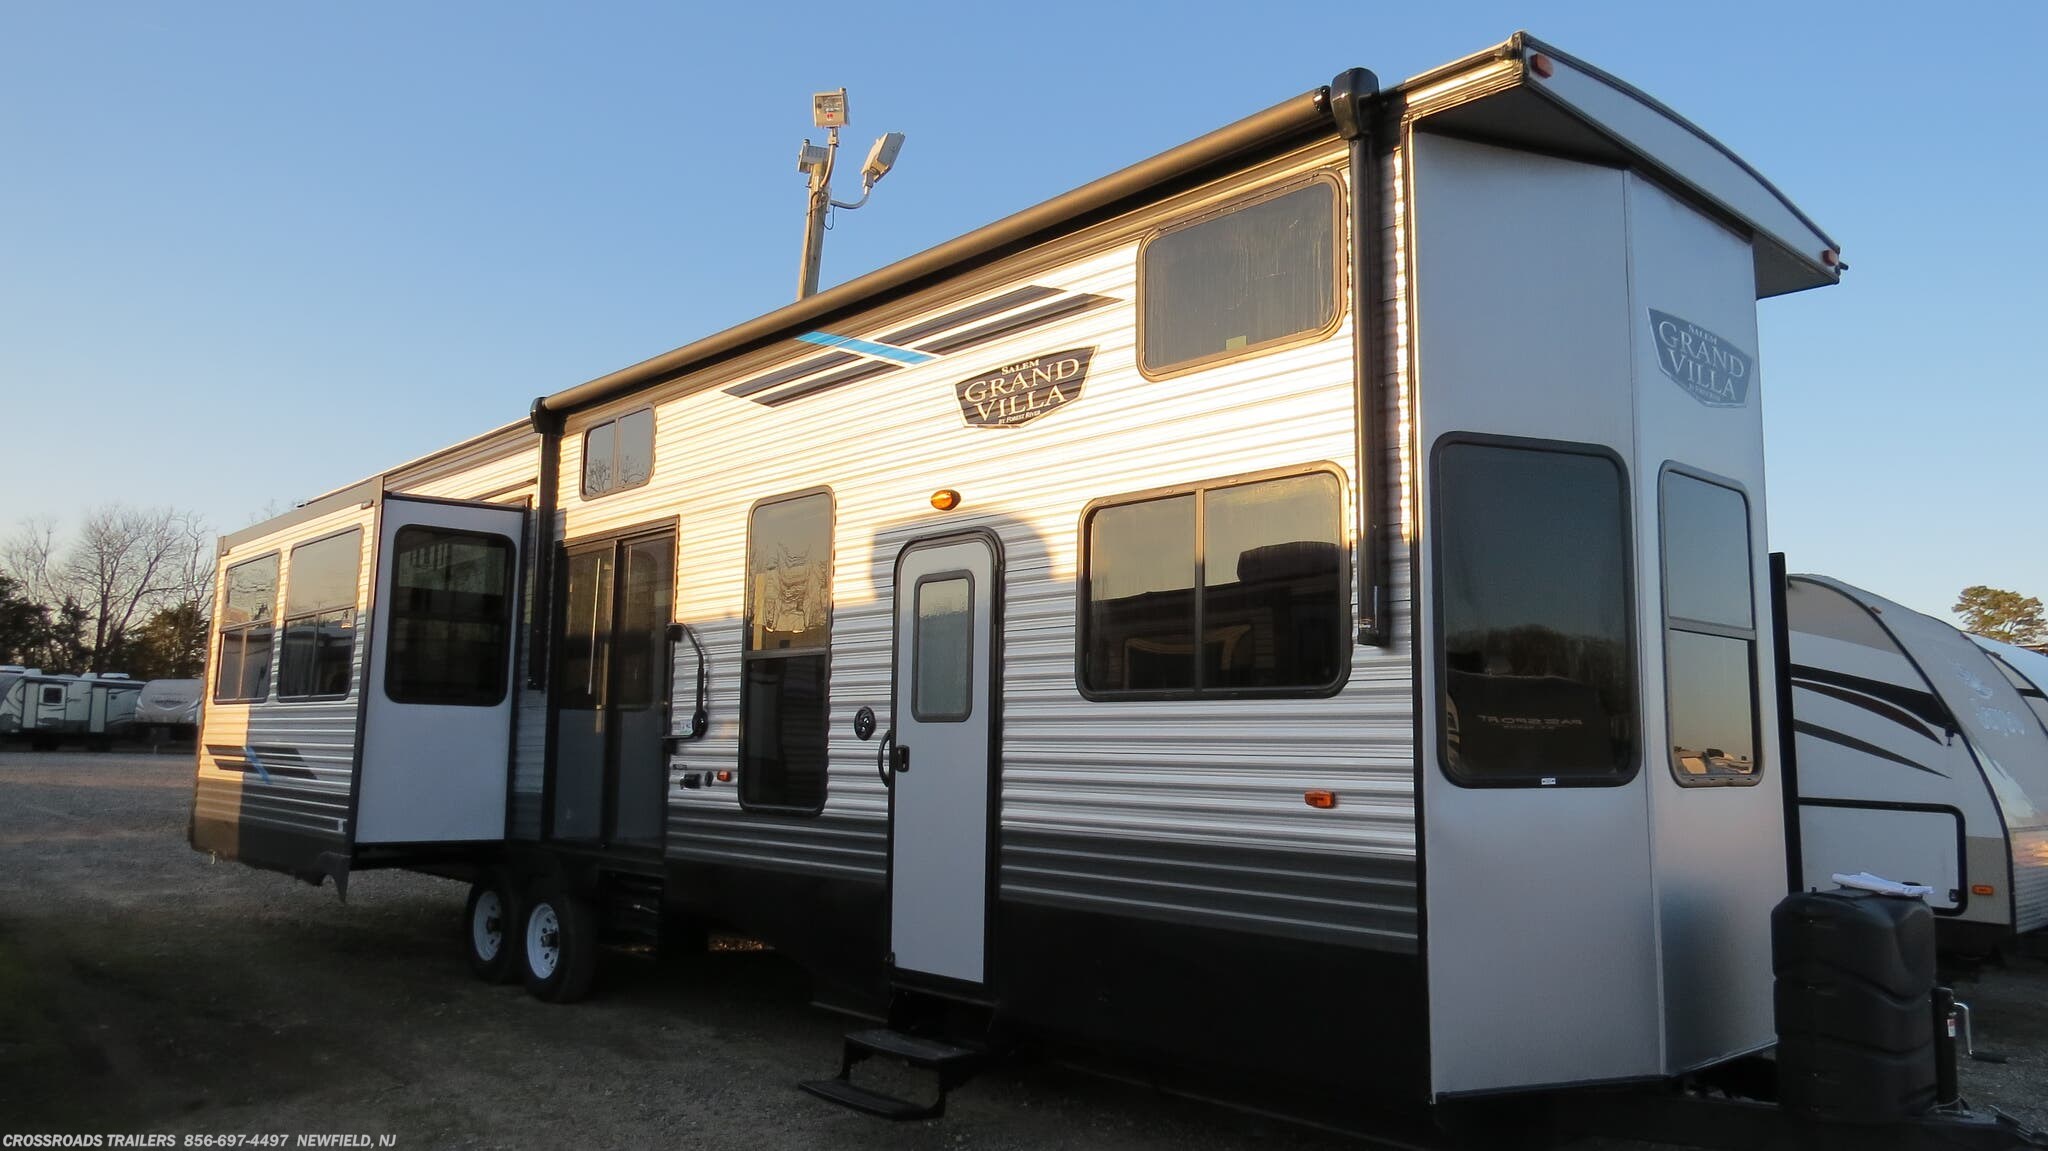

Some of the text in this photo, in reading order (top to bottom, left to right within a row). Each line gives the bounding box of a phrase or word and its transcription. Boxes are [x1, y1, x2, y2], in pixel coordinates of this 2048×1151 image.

[1001, 359, 1040, 375] SALEM
[1659, 321, 1744, 377] GRAND
[964, 358, 1080, 402] GRAND
[1667, 348, 1736, 400] VILLA
[974, 385, 1068, 421] VILLA
